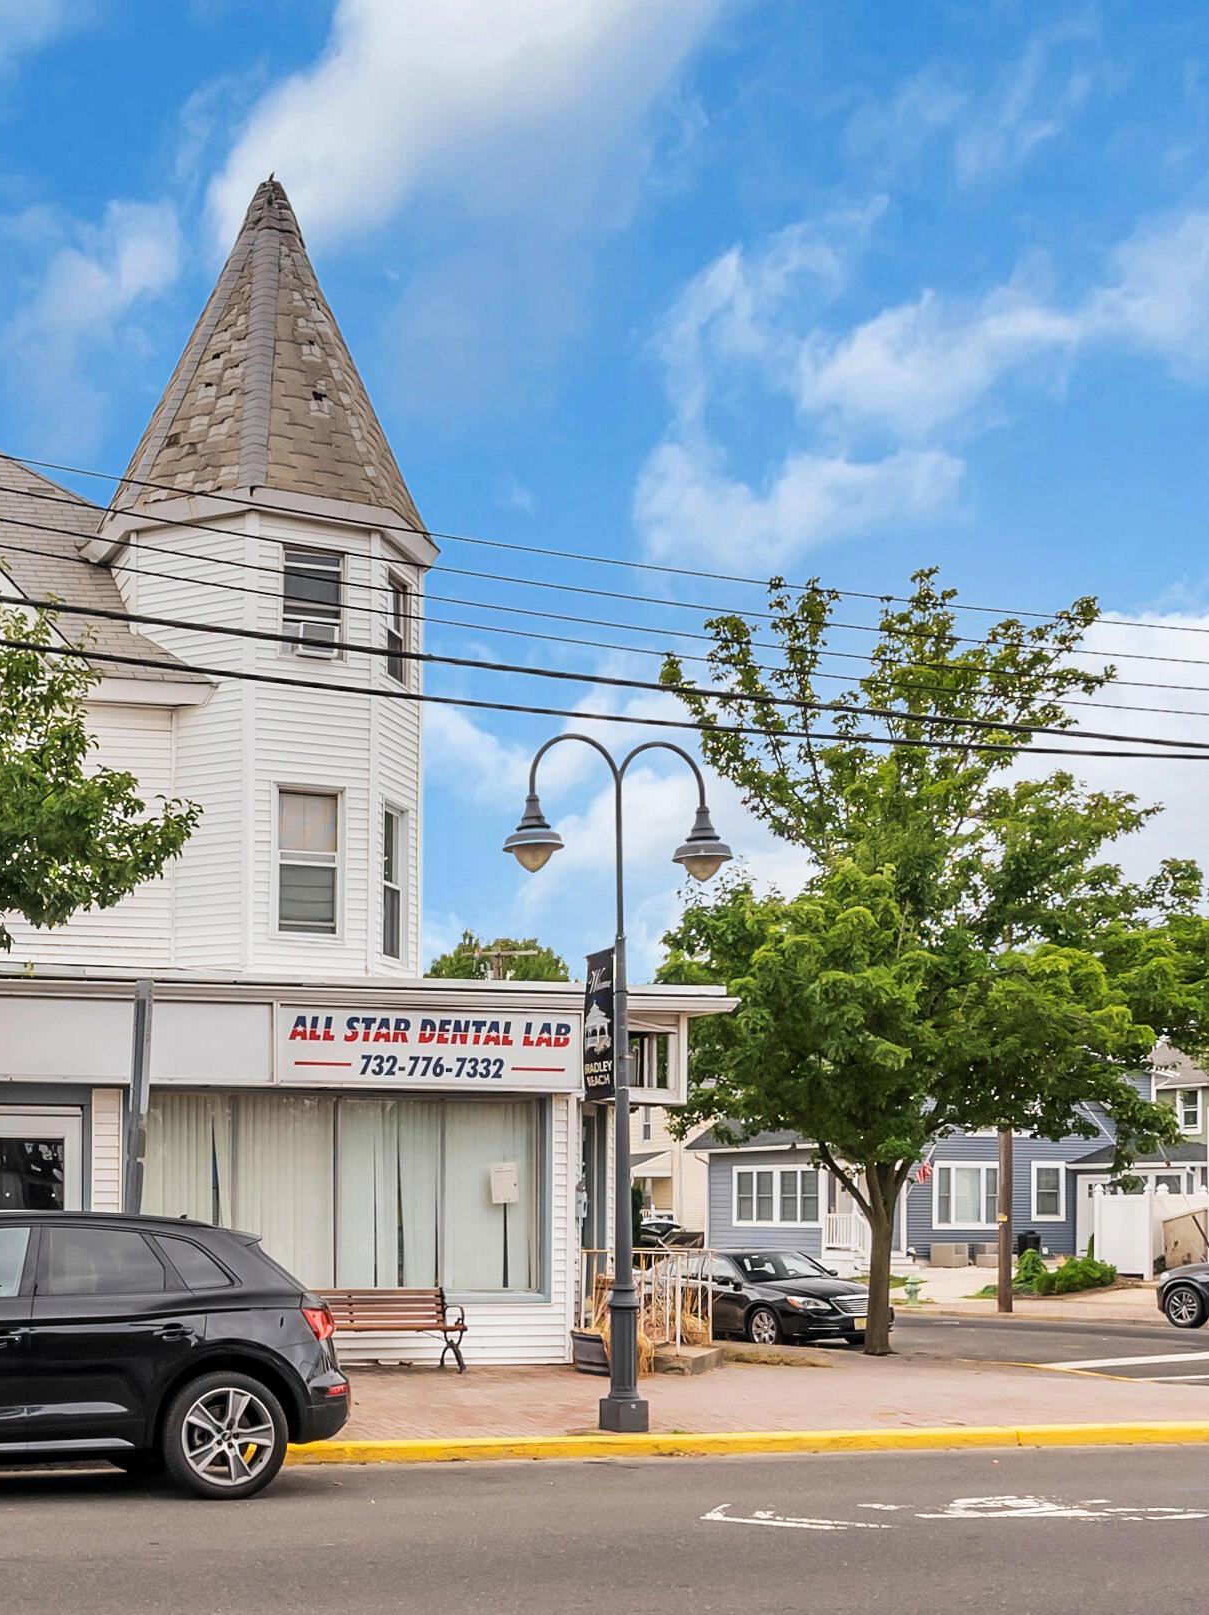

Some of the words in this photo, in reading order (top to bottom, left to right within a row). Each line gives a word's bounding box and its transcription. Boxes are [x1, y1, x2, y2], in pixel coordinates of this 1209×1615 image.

[289, 1015, 335, 1041] ALL
[344, 1015, 411, 1043] STAR
[418, 1018, 514, 1046] DENTAL
[522, 1021, 571, 1048] LAB
[359, 1054, 505, 1079] 732-776-7332
